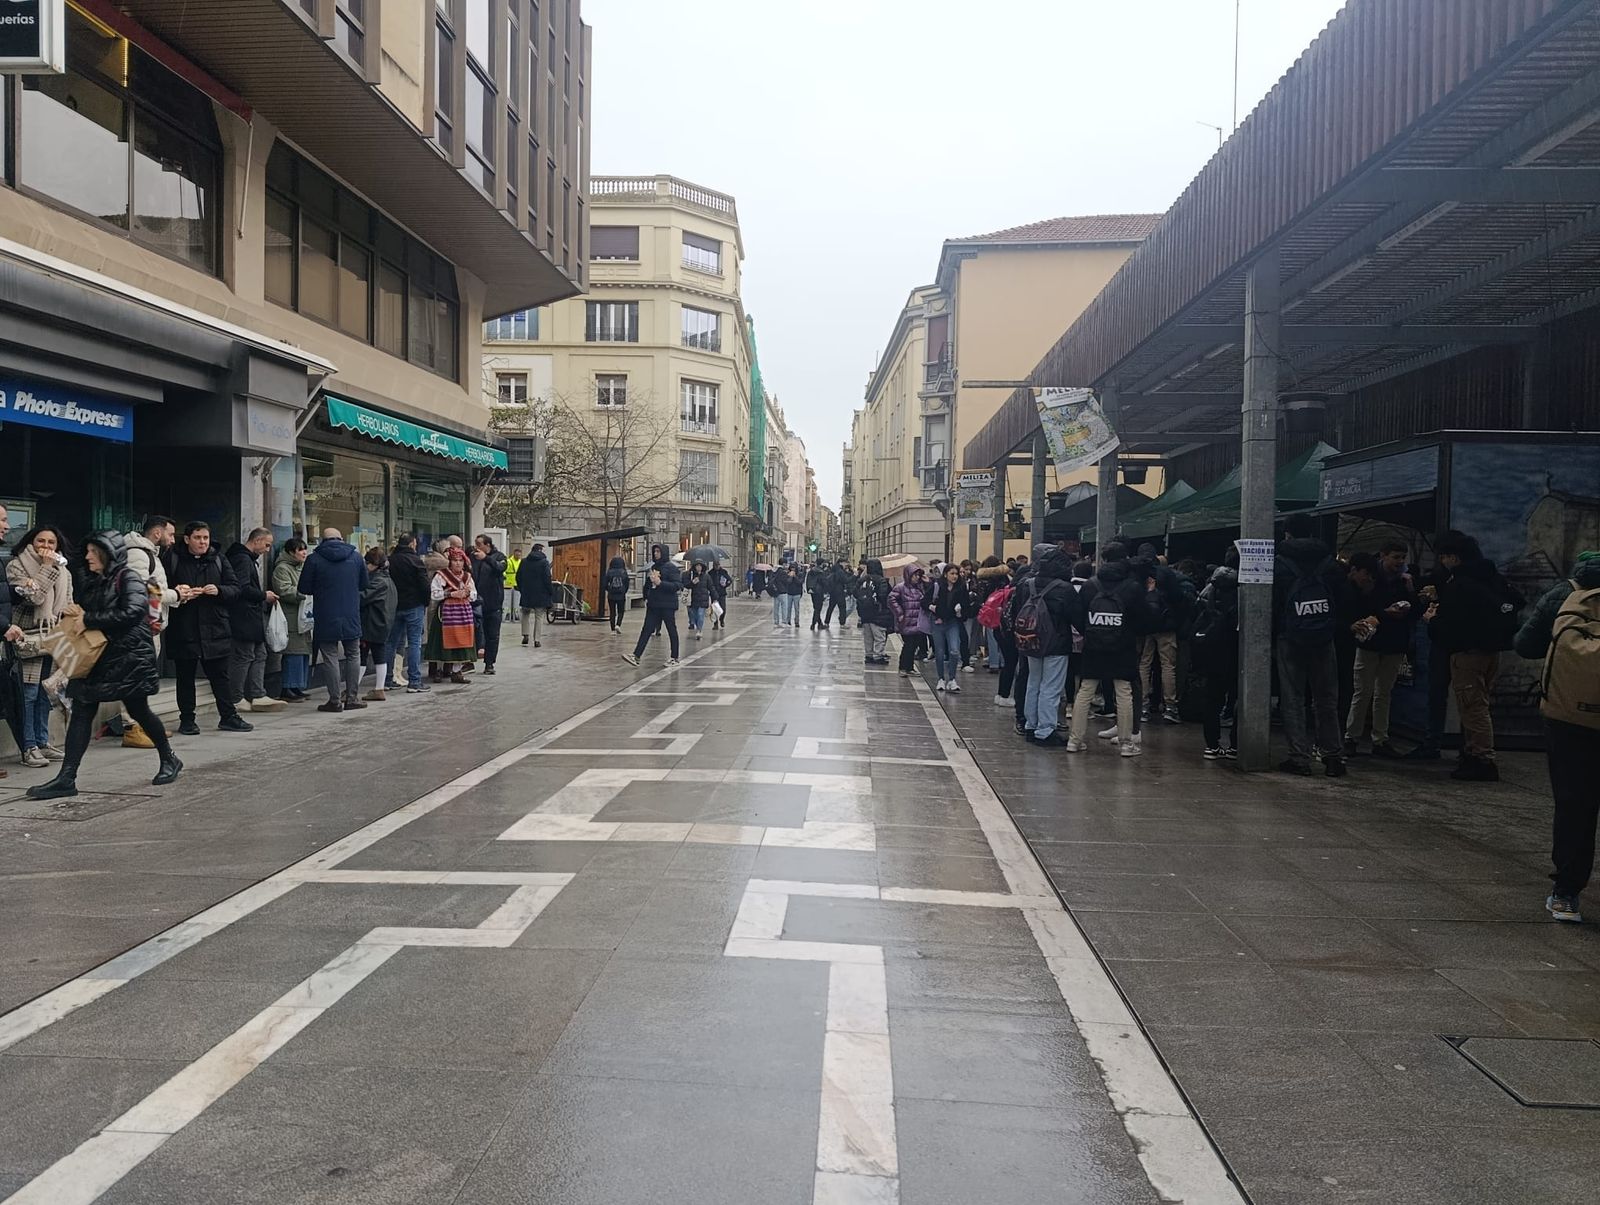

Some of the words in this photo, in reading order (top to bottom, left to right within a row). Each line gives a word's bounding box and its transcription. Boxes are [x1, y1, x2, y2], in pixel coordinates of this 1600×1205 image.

[14, 391, 60, 417] Photo
[65, 401, 124, 428] Express
[356, 411, 400, 437] HERBOLARIOS
[1294, 599, 1329, 616] VANS
[1088, 611, 1123, 626] VANS
